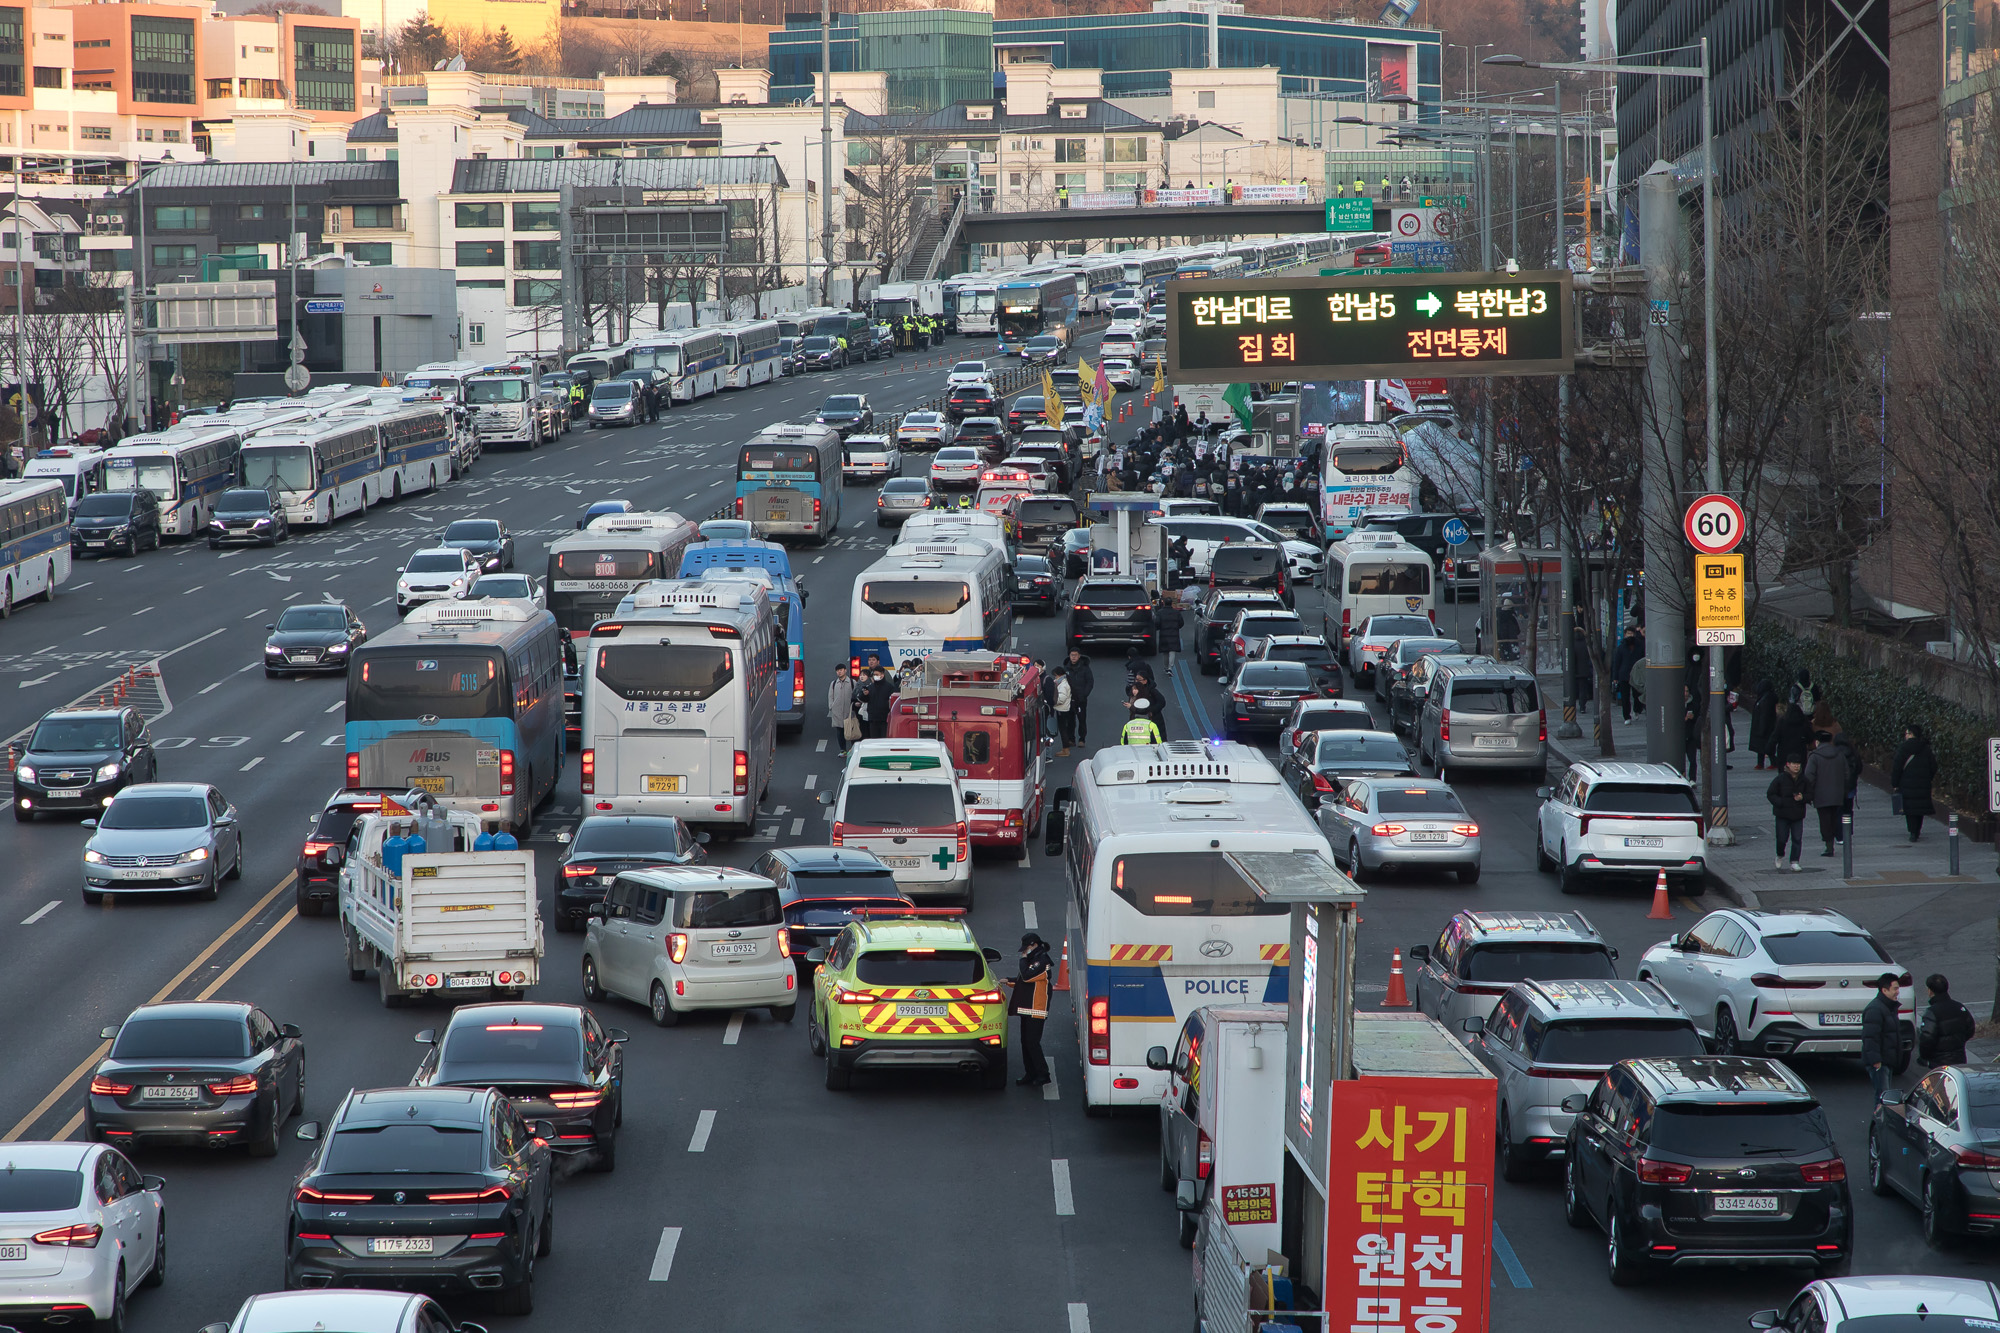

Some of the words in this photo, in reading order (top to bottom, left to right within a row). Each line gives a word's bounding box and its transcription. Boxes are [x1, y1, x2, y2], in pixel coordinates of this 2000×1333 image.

[1404, 221, 1414, 229] 60
[1191, 295, 1293, 325] 한남대로
[1327, 292, 1396, 322] 한남5
[1454, 288, 1548, 319] 북한남3
[1407, 327, 1508, 359] 전면통제
[1344, 475, 1395, 483] 코리아투어스
[988, 494, 1012, 505] 119
[1333, 493, 1375, 506] 내란수괴
[1377, 493, 1409, 505] 윤석열
[1698, 512, 1731, 536] 60
[595, 564, 615, 575] 8100
[1703, 588, 1737, 601] 단속중
[1706, 631, 1736, 642] 250m
[899, 648, 933, 657] POLICE
[624, 702, 707, 713] 서울고속관광
[409, 748, 450, 763] MBUS
[899, 859, 916, 867] 9349
[733, 944, 752, 952] 0932
[1184, 979, 1249, 995] POLICE
[923, 1006, 944, 1015] 5010
[1847, 1014, 1862, 1022] 592
[170, 1088, 193, 1097] 2564
[1354, 1105, 1468, 1163] 사기
[1356, 1169, 1467, 1227] 탄핵
[1748, 1198, 1774, 1209] 4636
[1227, 1198, 1271, 1210] 부정의혹
[1227, 1209, 1272, 1222] 해명하라
[405, 1239, 431, 1249] 2323
[0, 1247, 20, 1258] 081
[1352, 1232, 1464, 1289] 원천
